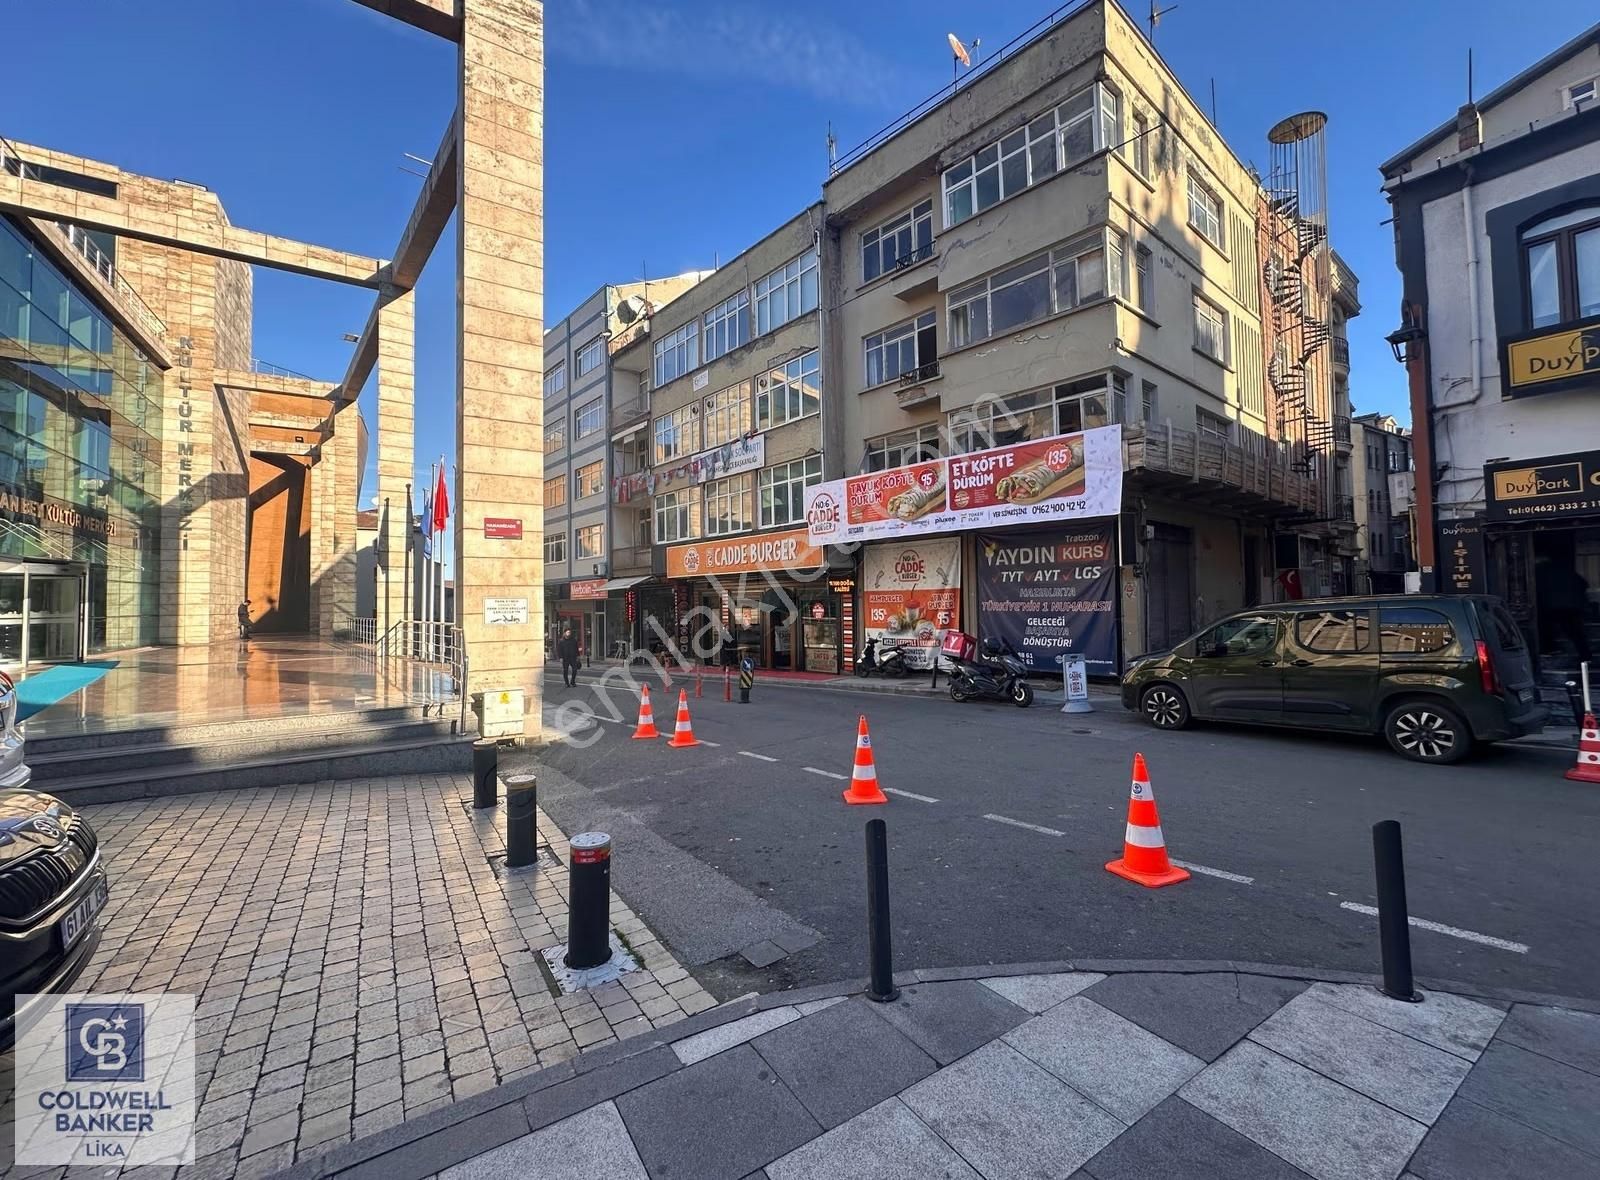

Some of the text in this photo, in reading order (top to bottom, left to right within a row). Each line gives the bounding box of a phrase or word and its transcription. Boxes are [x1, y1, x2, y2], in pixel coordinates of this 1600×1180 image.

[179, 336, 193, 433] KÜLTÜR
[952, 453, 1014, 477] ET KÖFTE
[1048, 449, 1068, 465] 135
[850, 472, 914, 495] TAVUK KÖFTE
[921, 472, 933, 486] 95
[952, 473, 994, 490] DÜRÜM
[1506, 478, 1570, 493] DuyPark
[850, 490, 883, 507] DÜRÜM
[1559, 502, 1578, 510] 333
[807, 505, 840, 525] CADDE
[1032, 500, 1087, 514] 0462 400 42 42
[47, 503, 82, 529] KÜLTÜR
[934, 516, 956, 525] pluxee
[814, 522, 832, 532] BURGER
[1065, 533, 1099, 543] Trabzon
[715, 544, 748, 566] CADDE
[750, 538, 797, 563] BURGER
[995, 545, 1104, 566] AYDIN KURS
[895, 560, 924, 574] CADDE
[1001, 566, 1101, 582] TYT AYT LGS
[1027, 616, 1066, 626] GELECEĞİ
[1023, 637, 1073, 648] DÖNÜŞTÜR!
[67, 911, 78, 939] 61
